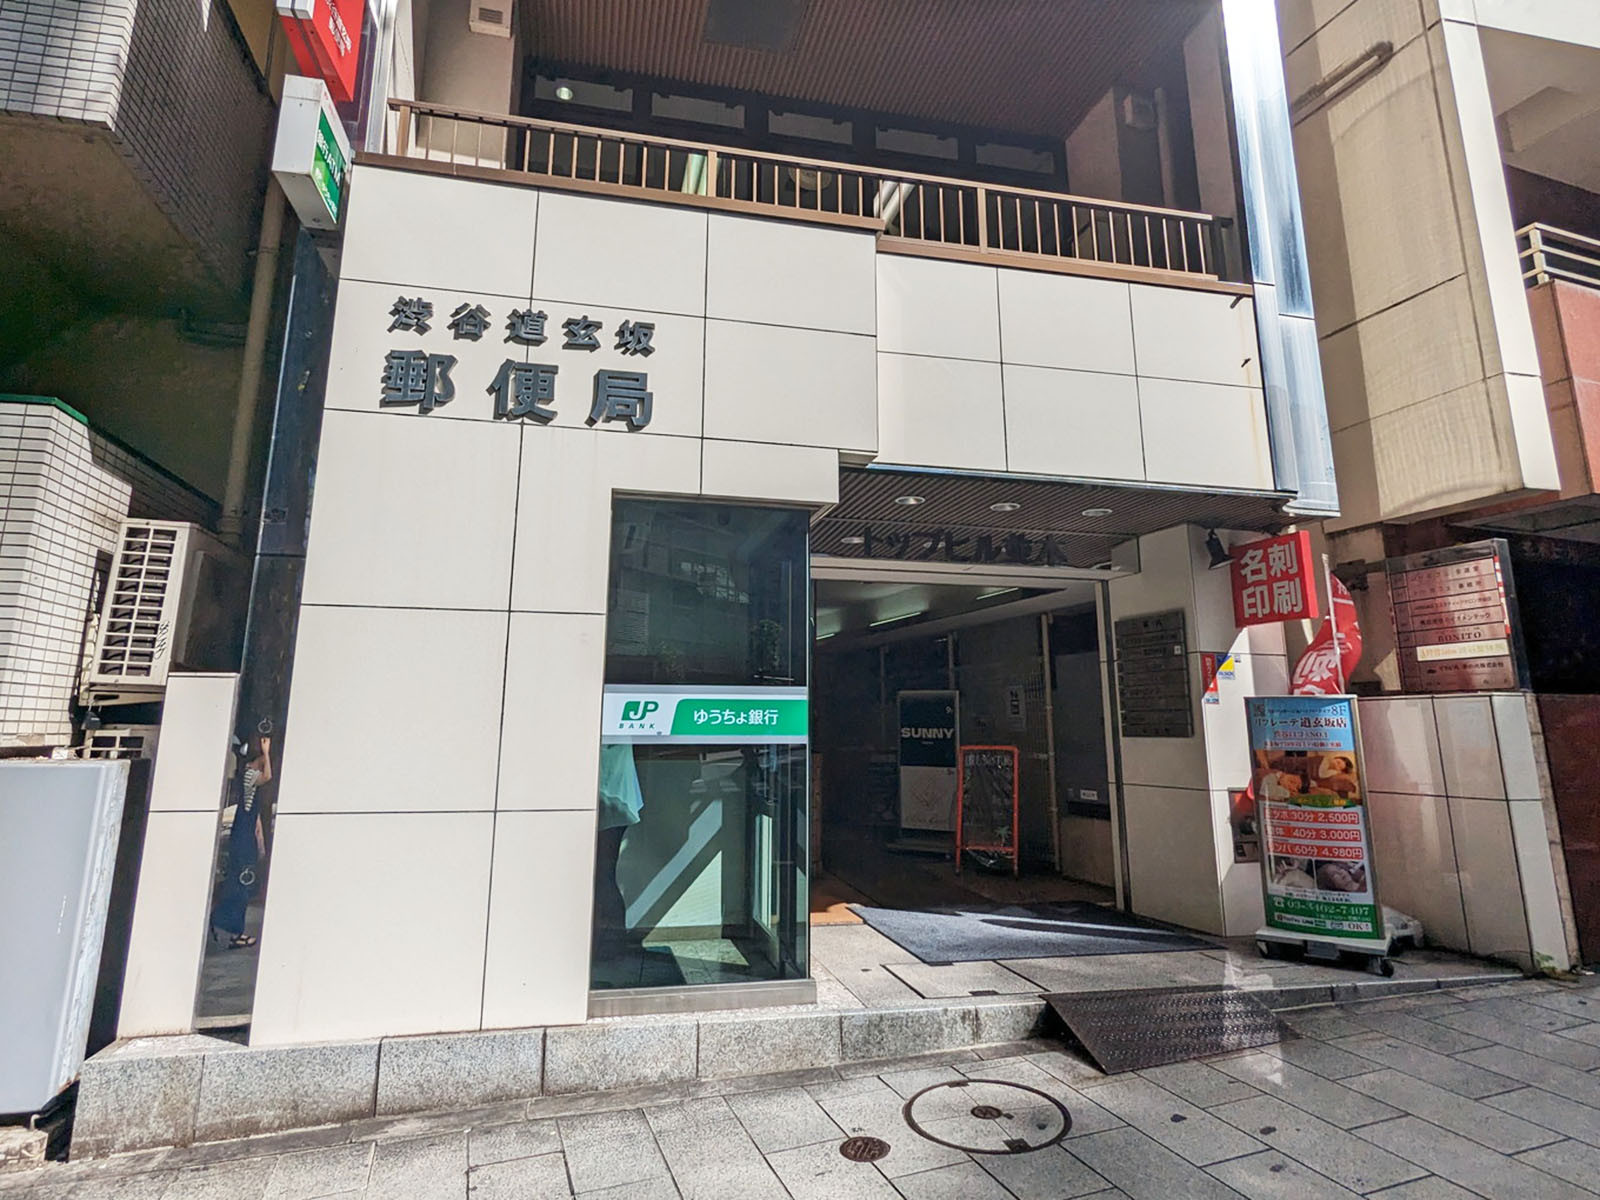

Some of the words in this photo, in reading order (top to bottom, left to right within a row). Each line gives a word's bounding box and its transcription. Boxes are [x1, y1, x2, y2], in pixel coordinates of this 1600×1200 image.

[387, 296, 656, 357] 渋谷道玄坂
[379, 349, 653, 432] 郵便局
[1240, 541, 1298, 584] 名刺
[1243, 578, 1303, 619] 印刷
[1438, 631, 1481, 642] BONITO
[621, 701, 659, 721] JP
[693, 709, 779, 725] ゆうちょ銀行
[1331, 705, 1346, 715] 8F
[901, 727, 954, 739] SUNNY
[1292, 811, 1314, 822] 30分
[1293, 828, 1316, 839] 40分
[1295, 845, 1318, 856] 60分
